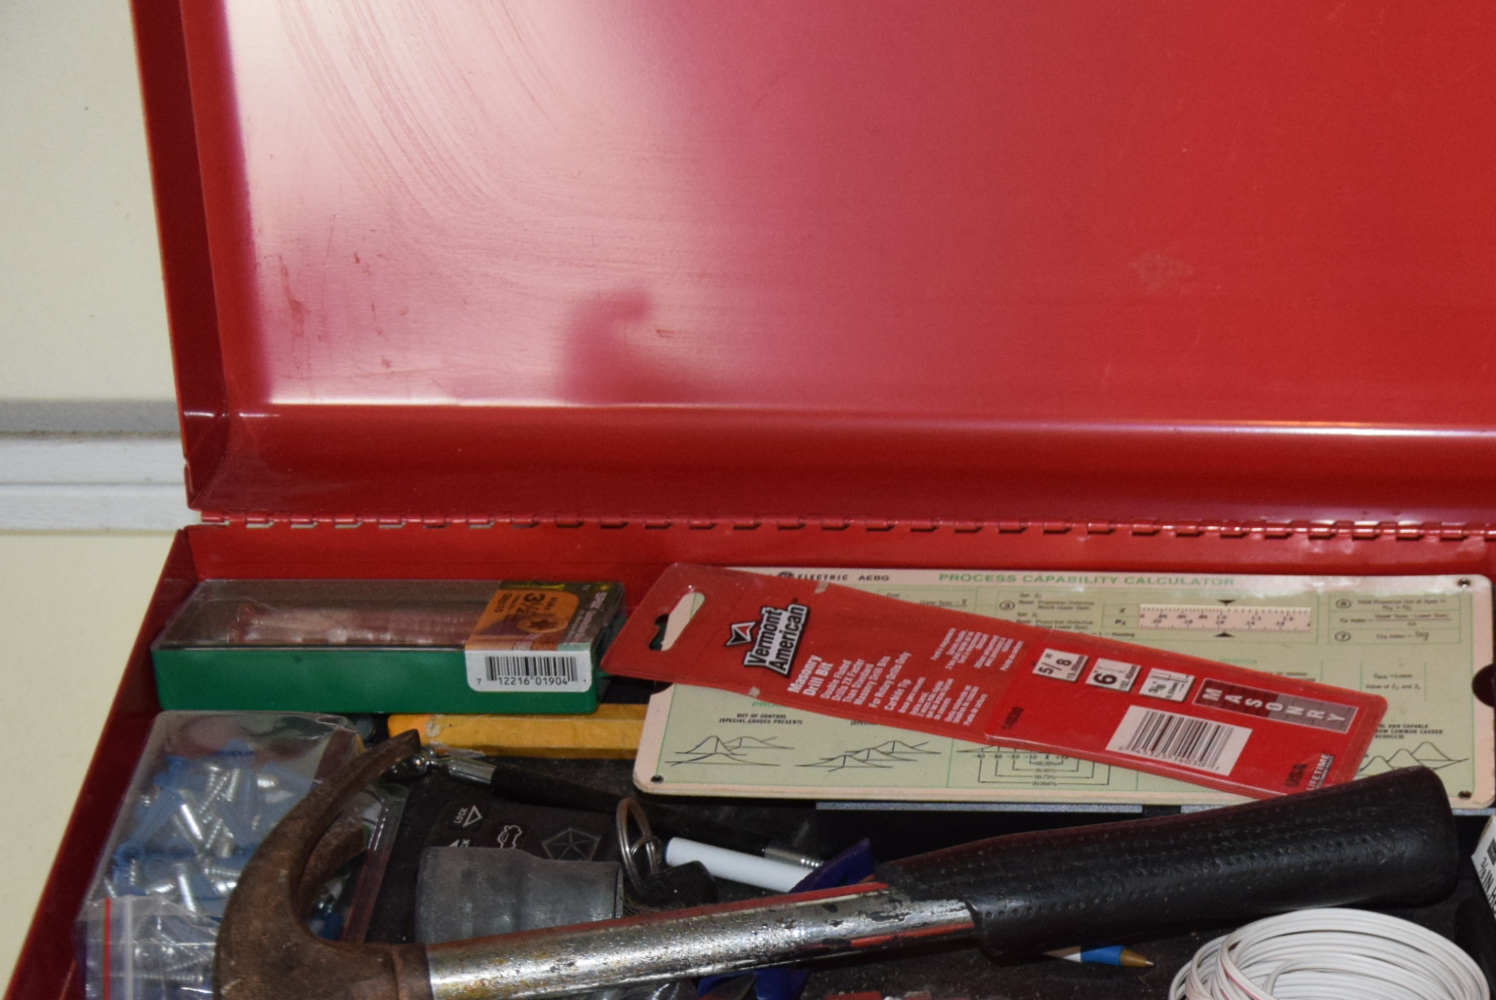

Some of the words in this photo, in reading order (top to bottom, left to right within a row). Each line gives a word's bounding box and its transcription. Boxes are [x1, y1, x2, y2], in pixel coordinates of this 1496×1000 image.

[938, 573, 1017, 584] PROCESS
[1022, 573, 1118, 585] CAPABILITY
[1124, 575, 1235, 587] CALCULATOR
[747, 609, 783, 666] Vermont
[769, 603, 806, 672] American
[787, 654, 822, 693] Masonry
[812, 661, 834, 676] Bit
[498, 676, 531, 686] 12216
[535, 676, 569, 686] 01904
[800, 676, 825, 695] Drill
